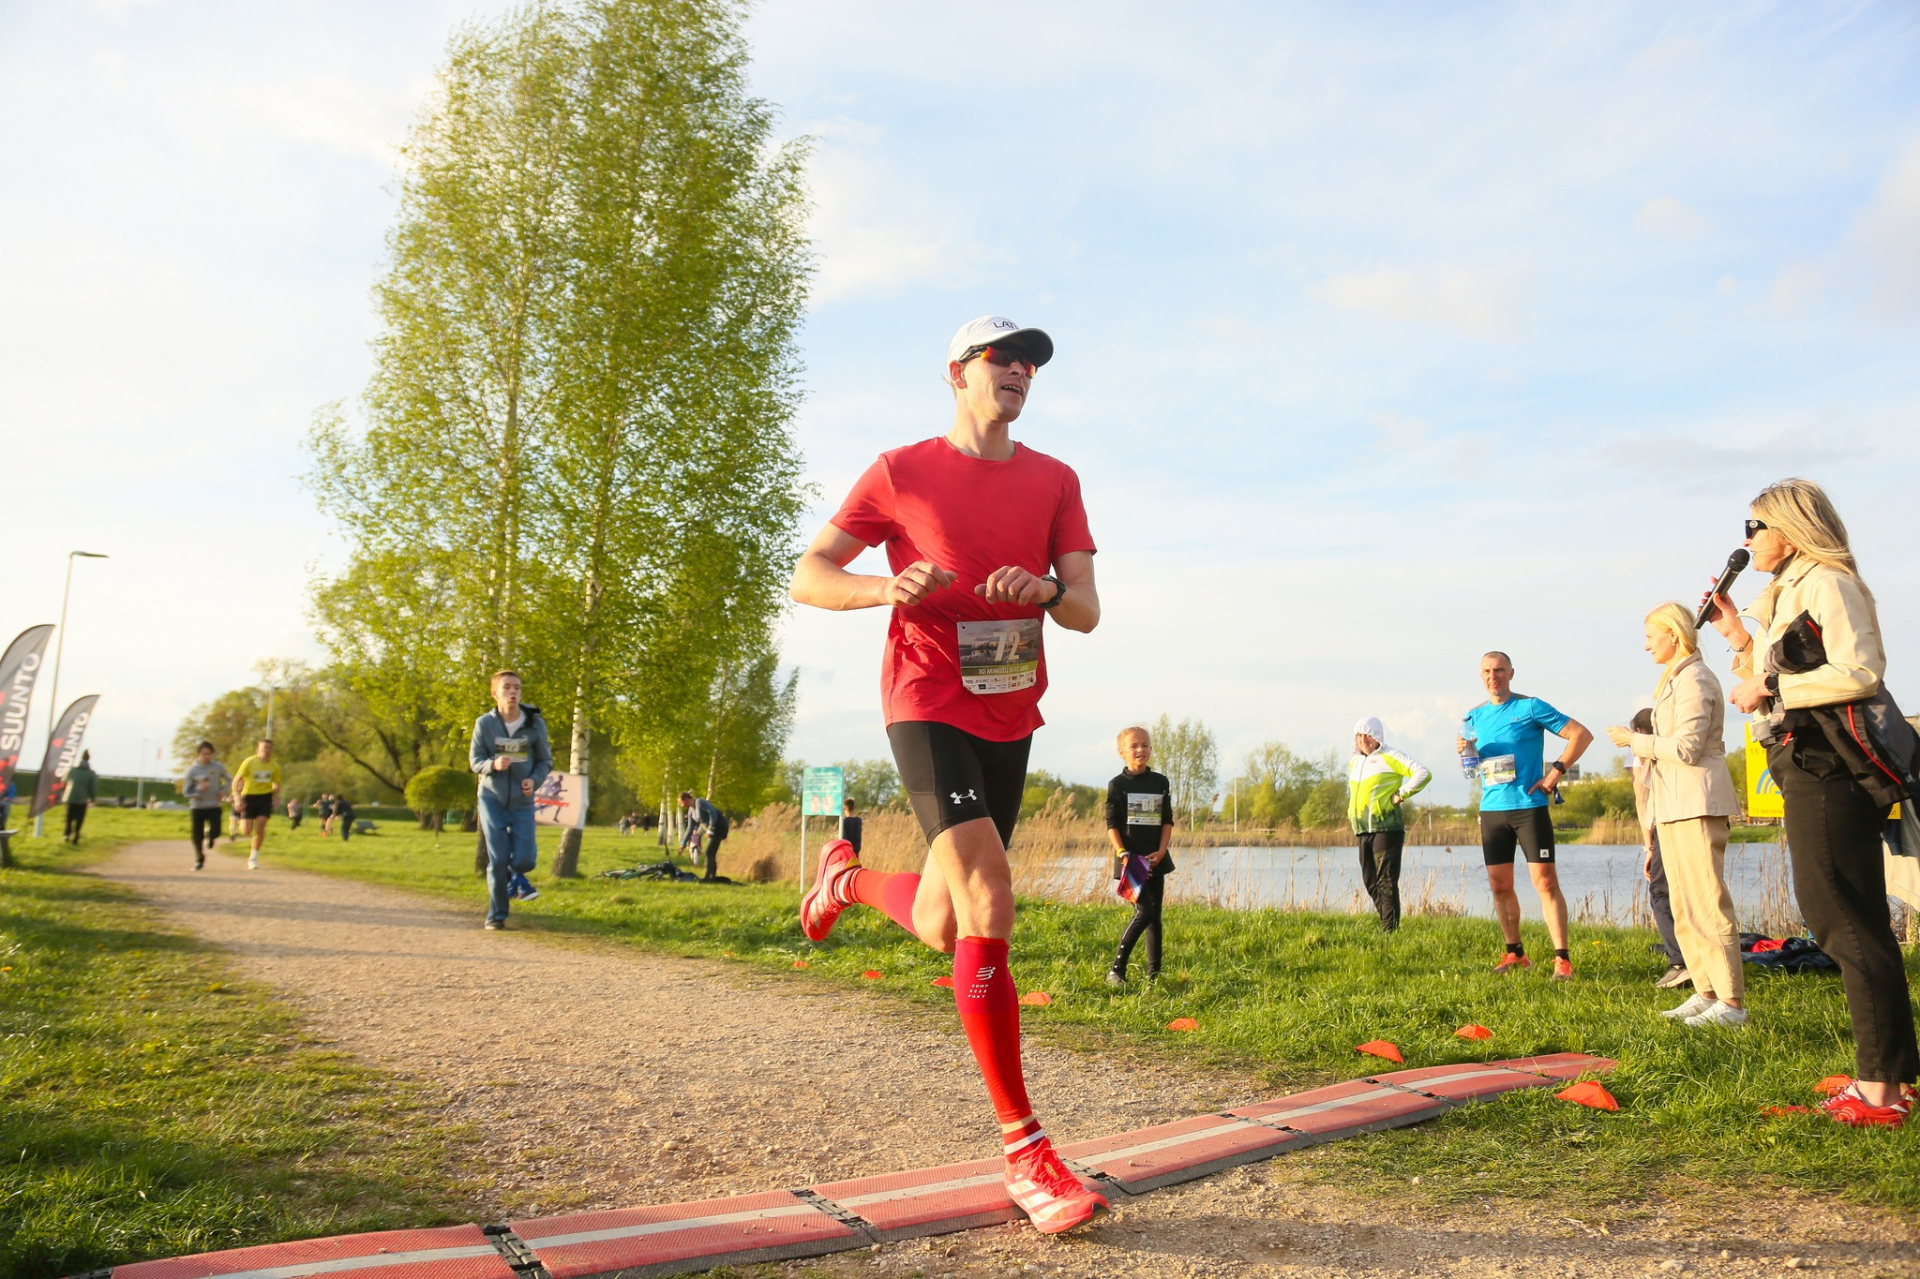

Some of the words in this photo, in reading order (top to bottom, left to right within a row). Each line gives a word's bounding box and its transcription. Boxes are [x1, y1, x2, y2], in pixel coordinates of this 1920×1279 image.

[993, 631, 1020, 661] 72
[0, 652, 40, 751] SUUNTO
[55, 712, 89, 778] SUUNTO
[1142, 798, 1155, 811] 64
